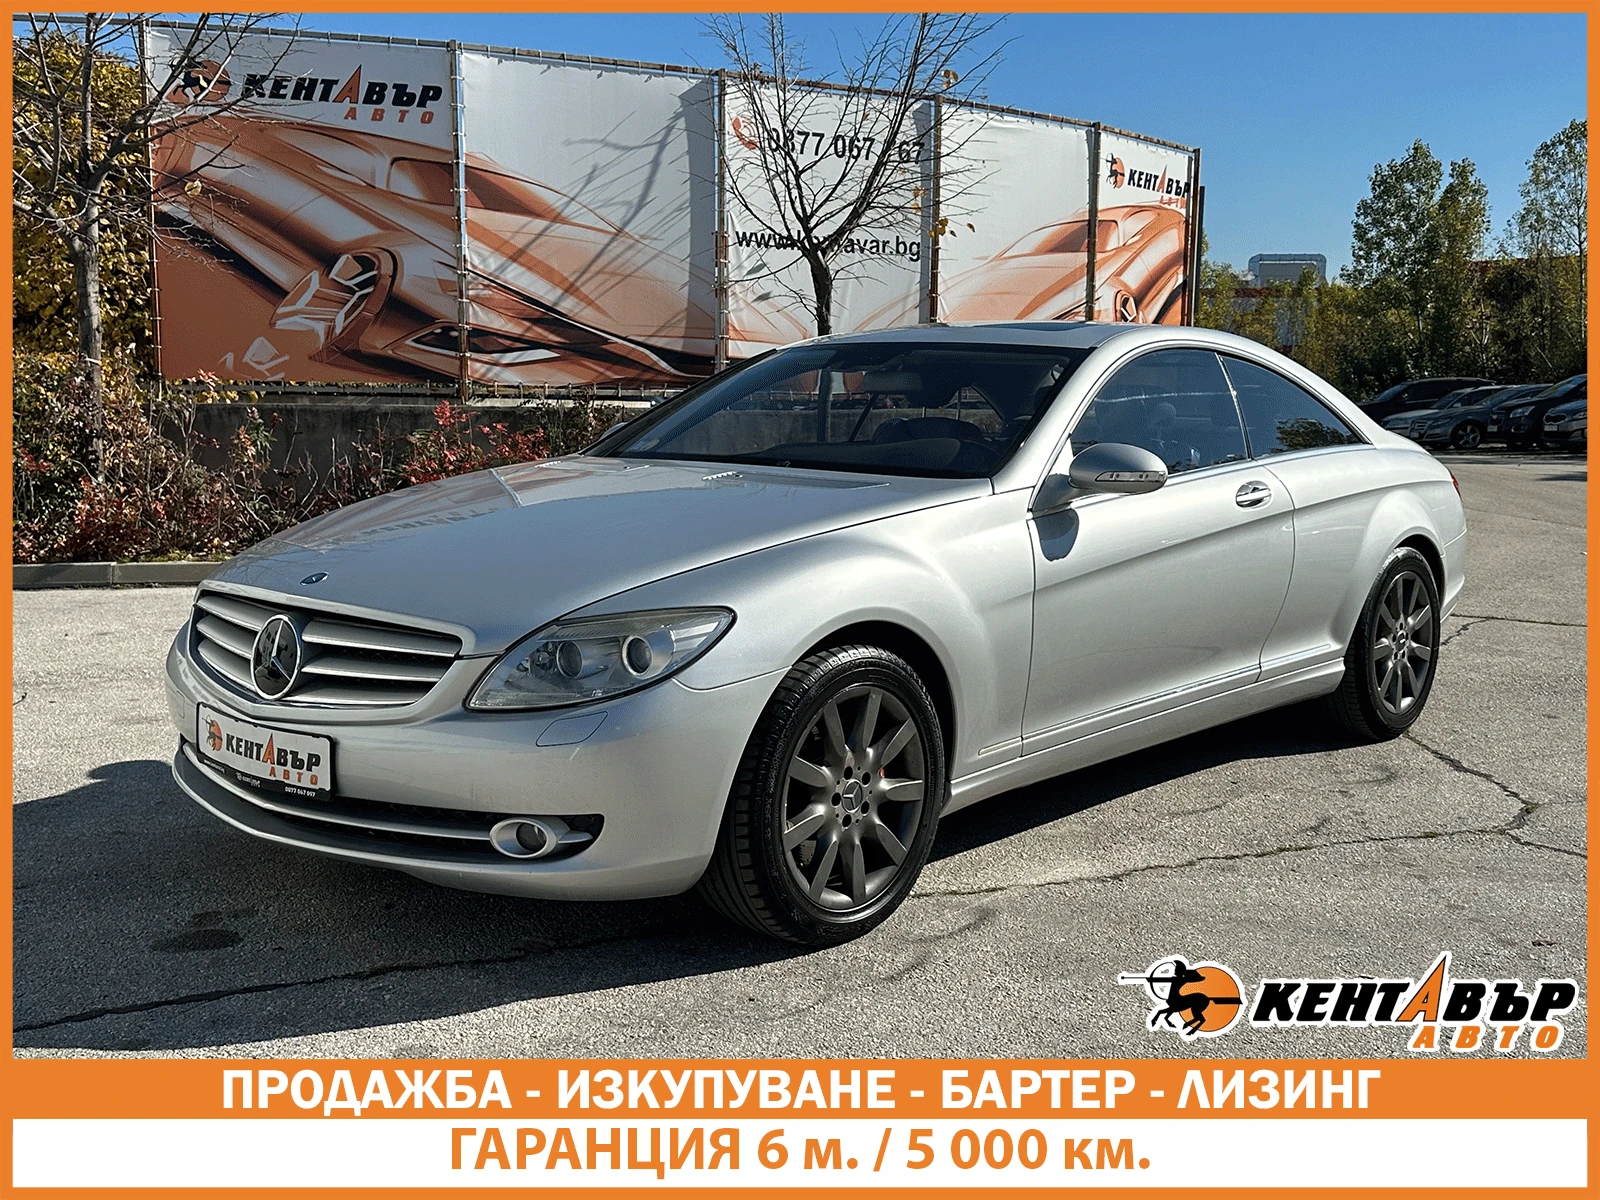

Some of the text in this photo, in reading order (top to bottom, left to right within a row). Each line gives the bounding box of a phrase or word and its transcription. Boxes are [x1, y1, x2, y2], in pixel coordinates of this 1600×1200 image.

[241, 64, 442, 108] КЕНТАВЪР
[344, 107, 434, 124] АВТО
[833, 134, 876, 161] 067
[1128, 165, 1190, 197] КЕНТАВЪР
[226, 733, 320, 771] КЕНТАВЪР
[269, 766, 318, 785] АВТО
